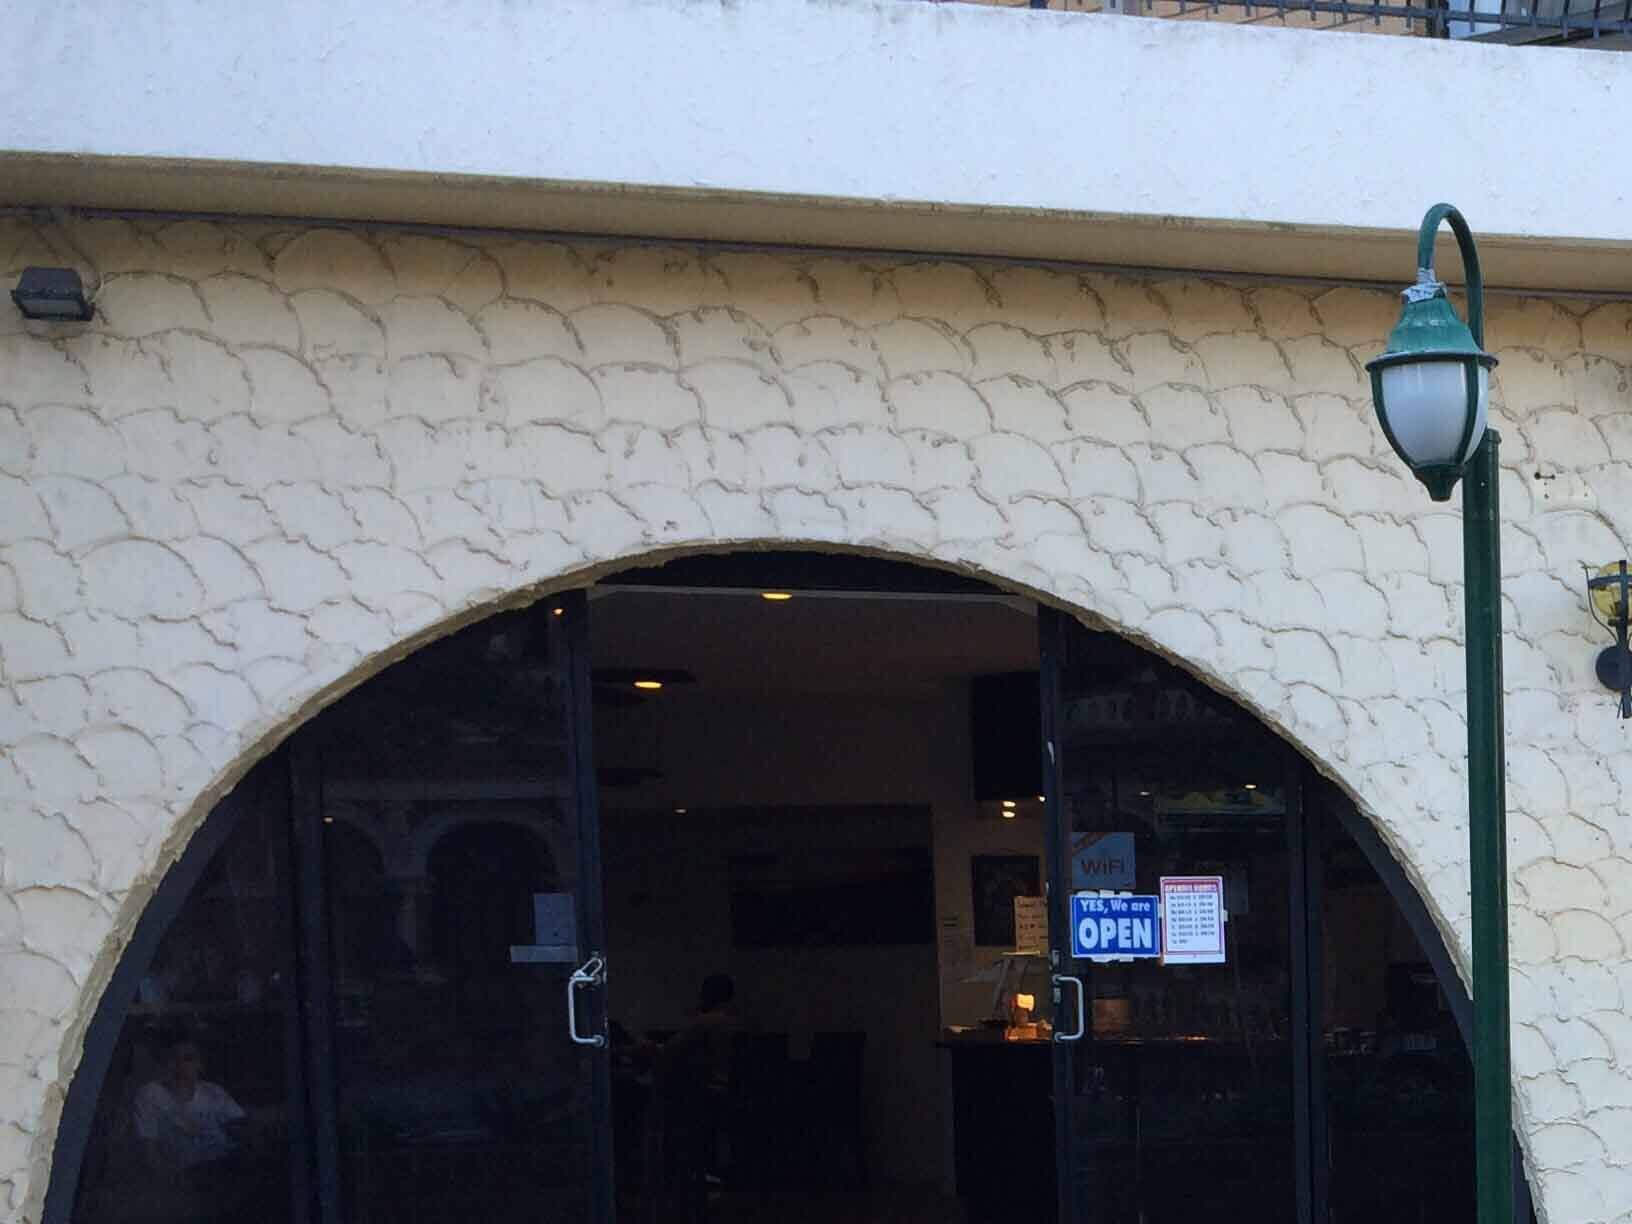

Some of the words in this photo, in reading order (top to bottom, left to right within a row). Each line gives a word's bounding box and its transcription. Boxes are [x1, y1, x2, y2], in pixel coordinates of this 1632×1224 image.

[1080, 899, 1108, 914] YES,
[1110, 899, 1128, 912] We
[1131, 901, 1151, 912] are
[1078, 917, 1152, 950] OPEN
